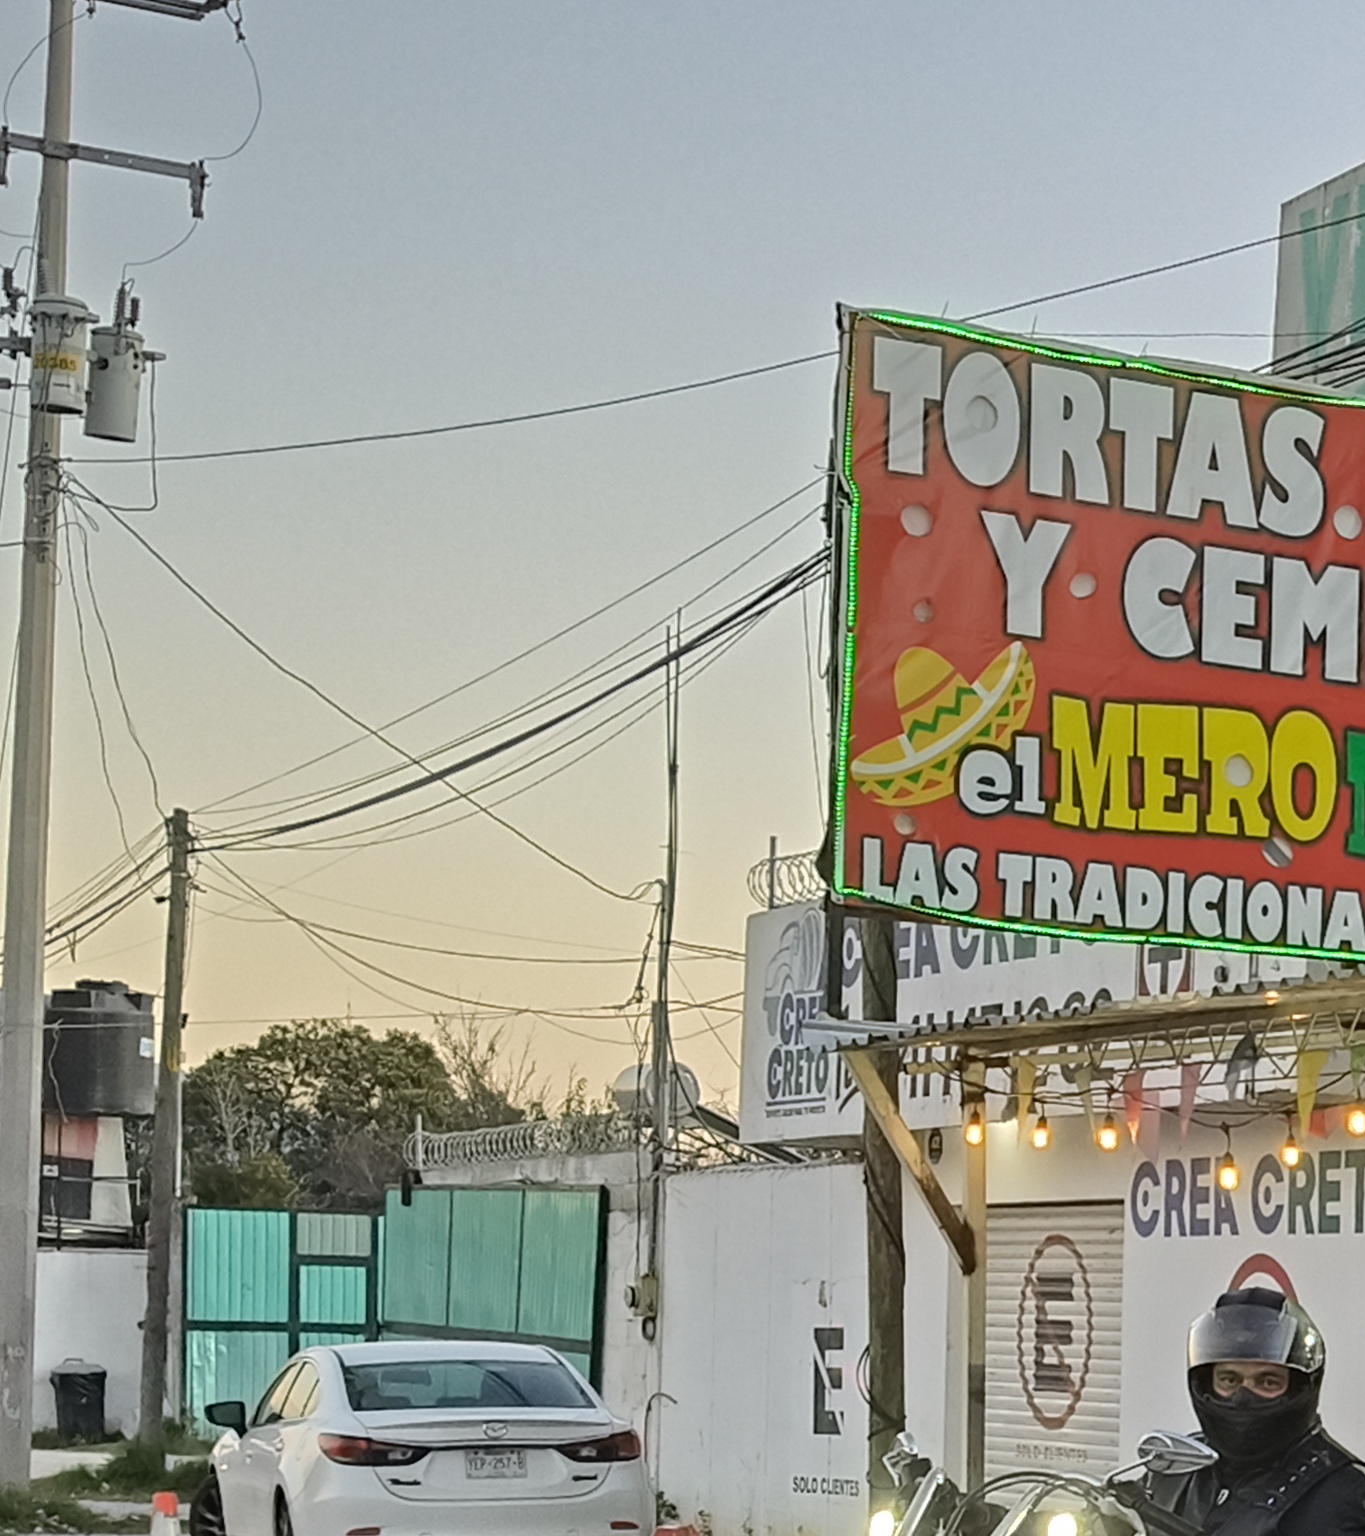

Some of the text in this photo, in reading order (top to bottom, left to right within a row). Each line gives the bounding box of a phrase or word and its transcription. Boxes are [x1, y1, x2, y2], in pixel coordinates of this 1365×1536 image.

[872, 336, 1326, 538] TORTAS
[981, 510, 1071, 639] Y
[1052, 694, 1337, 842] MERO
[862, 837, 979, 912] LAS
[768, 1047, 829, 1099] CRETO
[1130, 1156, 1240, 1238] CREA
[792, 1476, 860, 1498] SOLO CLIENTES
